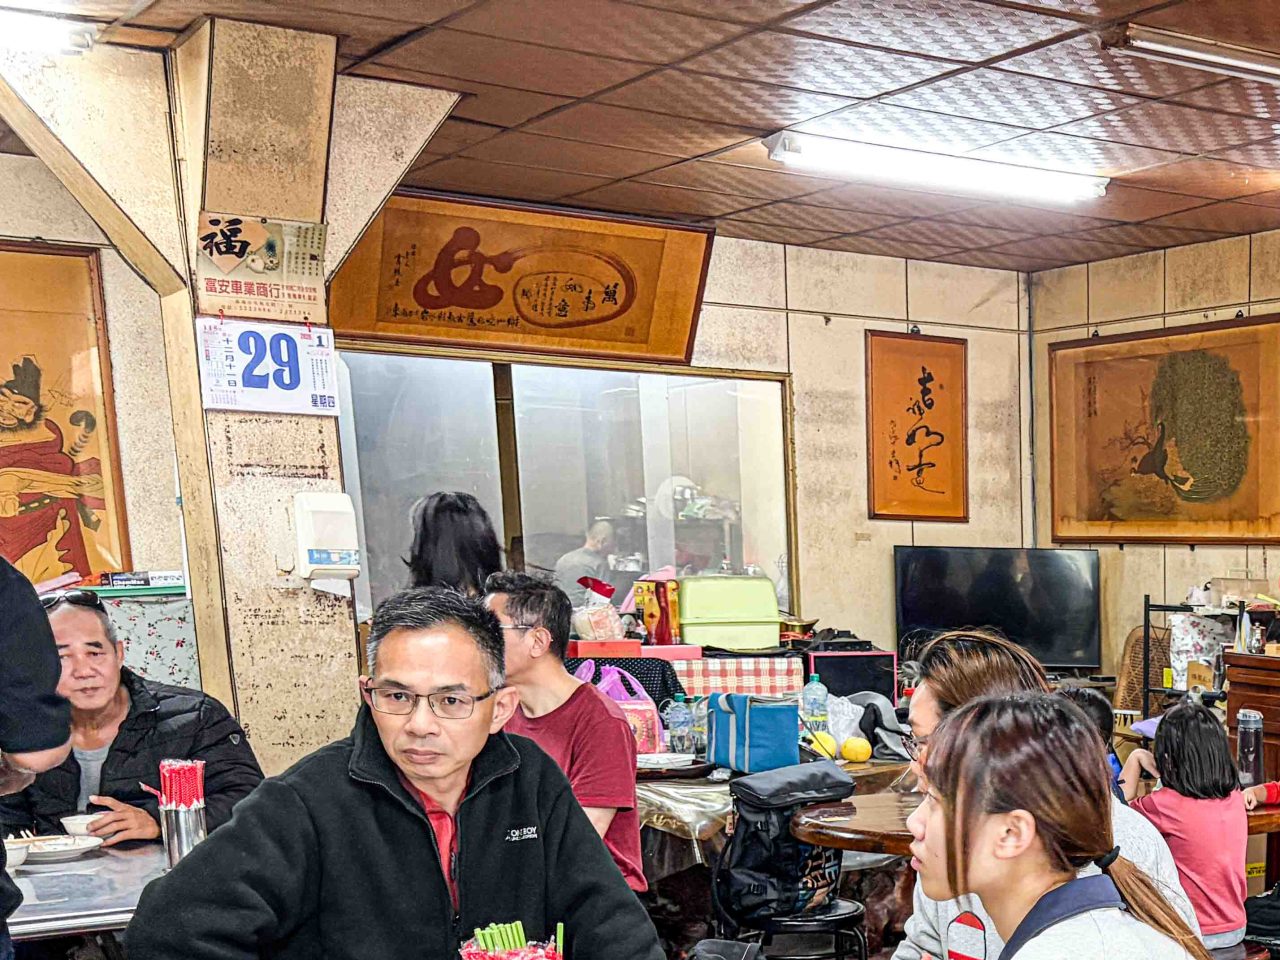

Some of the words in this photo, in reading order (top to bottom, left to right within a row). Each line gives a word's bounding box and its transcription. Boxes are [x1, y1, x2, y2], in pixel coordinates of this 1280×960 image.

[200, 218, 251, 259] 福
[204, 277, 280, 299] 富安車業商行
[238, 330, 301, 391] 29
